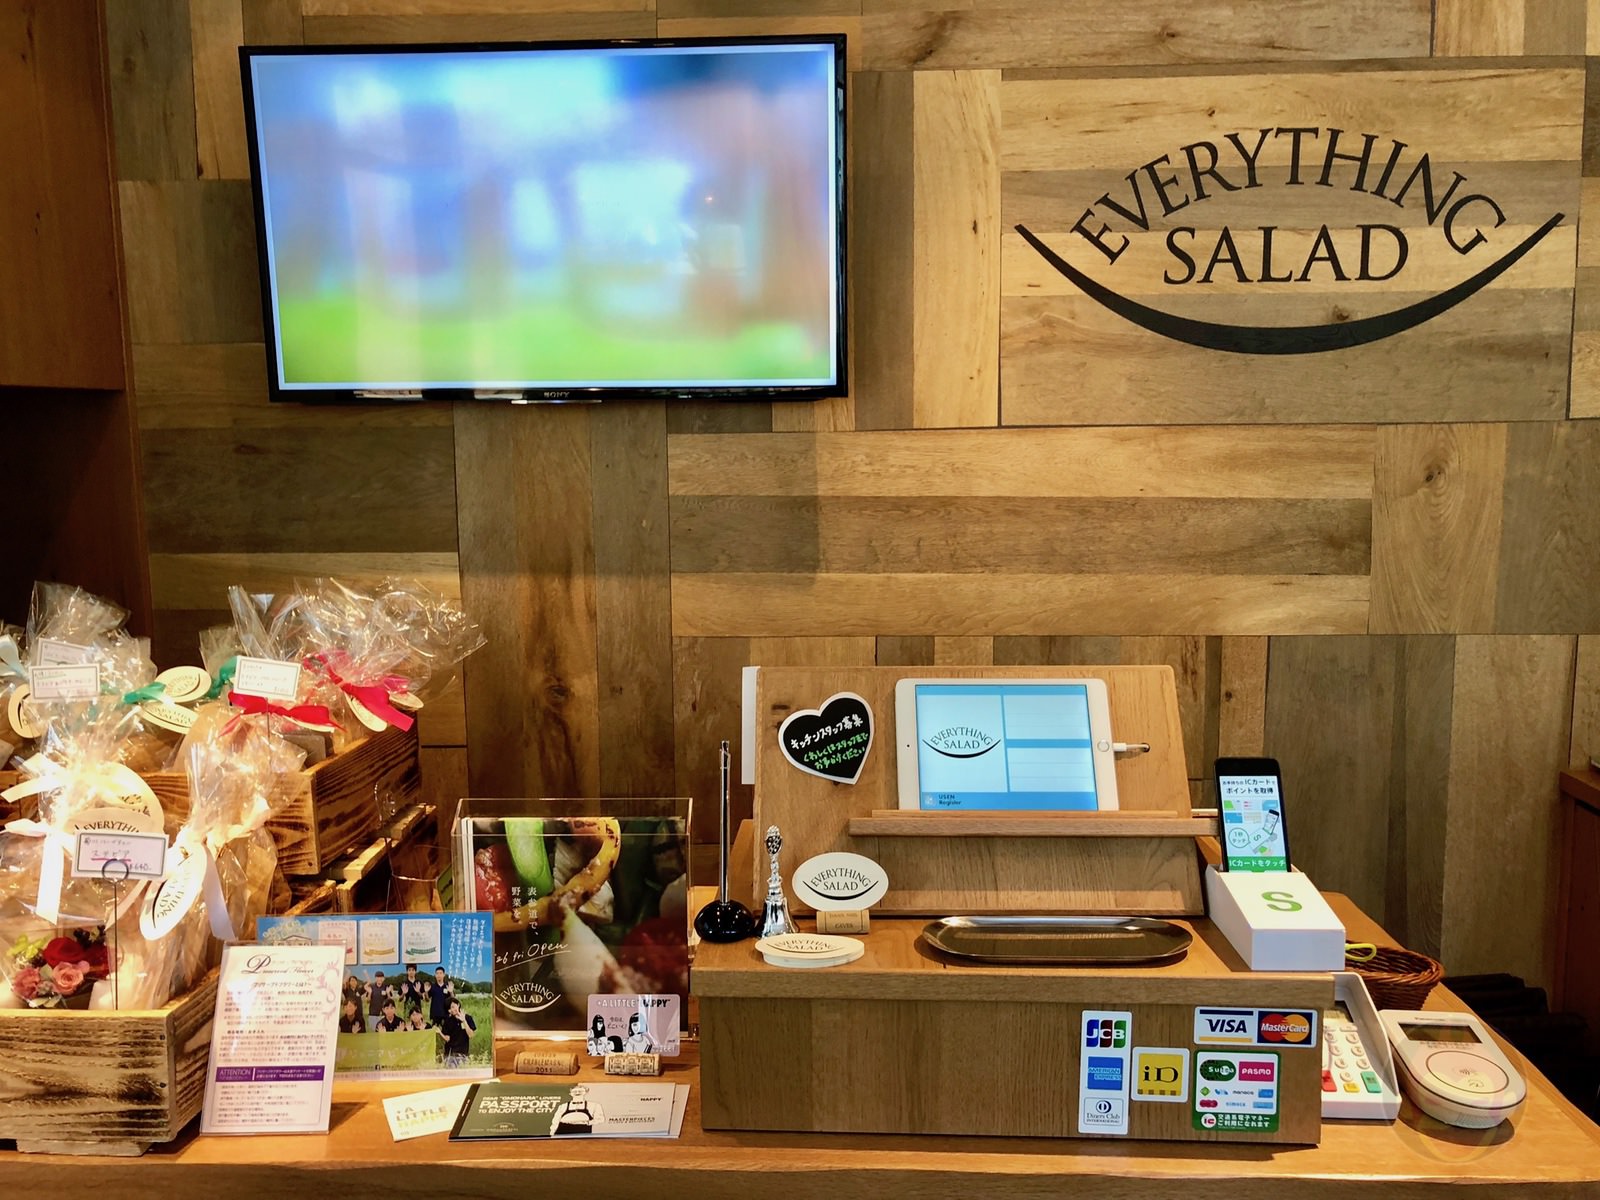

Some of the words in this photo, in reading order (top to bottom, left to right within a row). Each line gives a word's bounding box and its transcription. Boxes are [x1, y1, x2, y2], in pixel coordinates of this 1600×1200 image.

[1069, 127, 1507, 266] EVERYTHING
[1163, 224, 1409, 285] SALAD
[790, 713, 864, 750] キッチンスタッフ募集
[930, 726, 993, 746] EVERYTHING
[944, 739, 980, 749] SALAD
[1226, 786, 1274, 795] ポイントを取得
[938, 799, 962, 807] Register
[84, 820, 140, 832] EVERYTHI
[1229, 859, 1286, 867] ICカードをタッチ
[810, 867, 871, 888] EVERYTHING
[823, 881, 859, 891] SALAD
[1262, 891, 1303, 912] S
[527, 943, 569, 957] Open
[500, 982, 555, 1000] EVERYTHING
[511, 994, 543, 1004] SALAD
[609, 999, 635, 1007] LITTLE
[1205, 1018, 1248, 1033] VISA
[1260, 1022, 1309, 1033] MasterCard
[1086, 1028, 1126, 1040] JCB
[1143, 1065, 1179, 1082] iD
[1208, 1066, 1235, 1075] Suica
[1241, 1068, 1272, 1076] PASMO
[479, 1100, 561, 1109] PASSPORT
[1217, 1120, 1271, 1128] ご利用になれます
